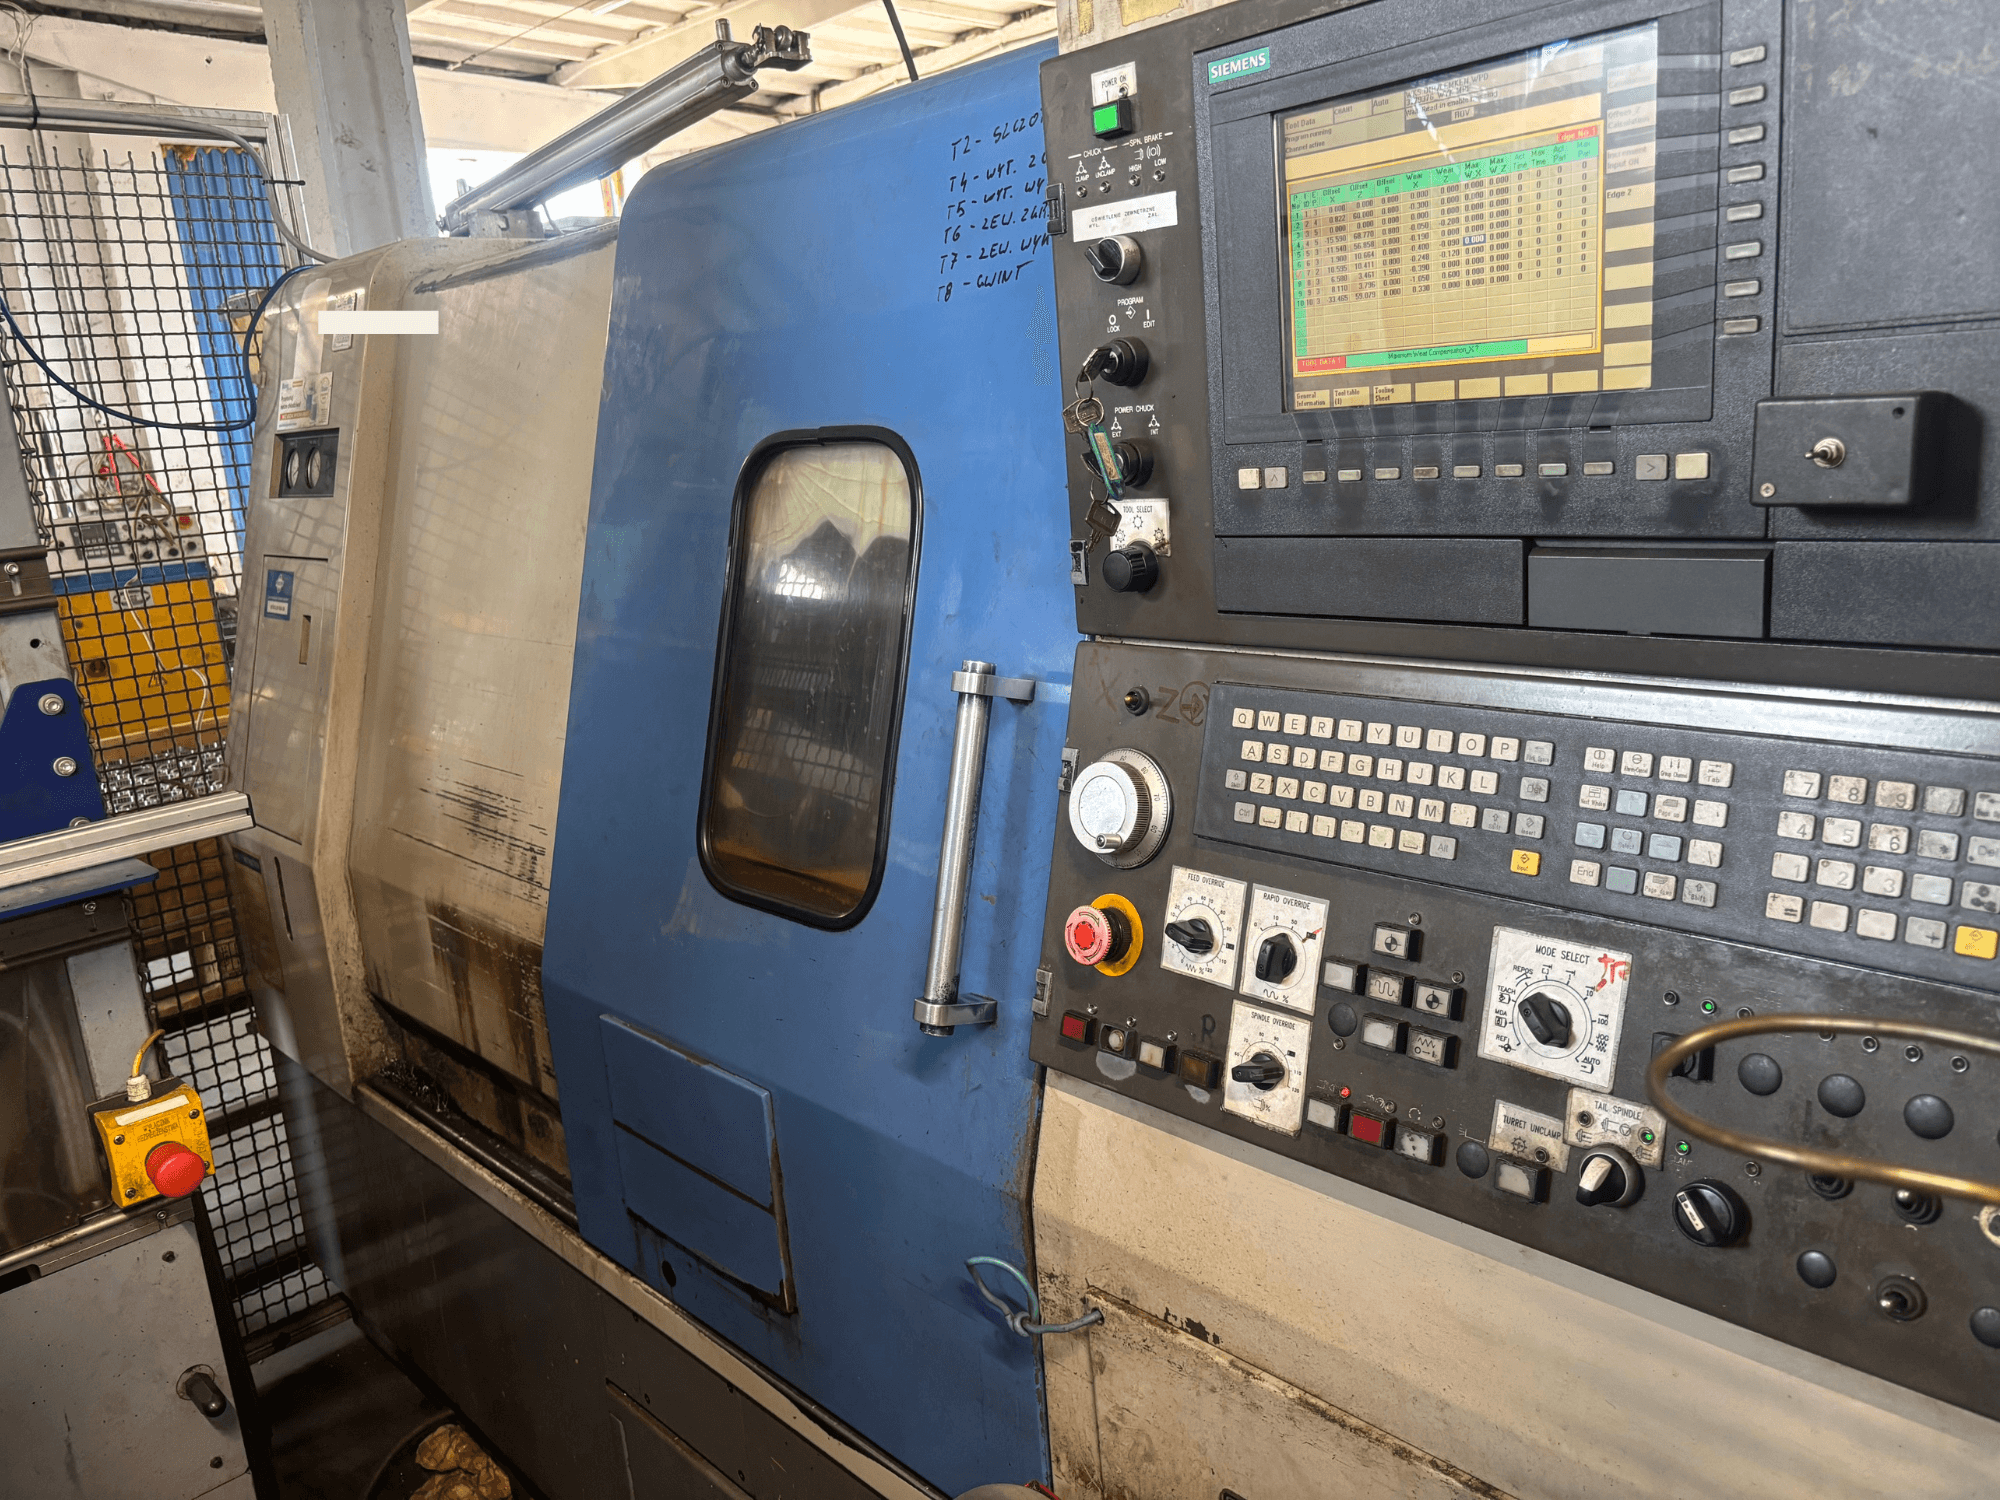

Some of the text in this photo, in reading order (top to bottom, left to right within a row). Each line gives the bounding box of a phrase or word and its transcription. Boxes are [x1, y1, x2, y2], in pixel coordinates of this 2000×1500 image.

[1211, 52, 1266, 79] SIEMENS
[1101, 74, 1126, 89] POWER ON
[1373, 98, 1389, 107] Auto
[1285, 118, 1316, 130] Tool Data
[1144, 132, 1162, 144] BRAKE
[1083, 147, 1102, 158] CHUCK
[1128, 164, 1142, 172] HIGH
[1154, 158, 1167, 167] LOW
[1075, 174, 1090, 183] CLAMP
[1095, 168, 1116, 178] UNCLAMP
[1607, 191, 1625, 199] Edge
[1117, 296, 1144, 306] PROGRAM
[1107, 325, 1120, 333] LOCK
[1143, 320, 1155, 328] EDIT
[1114, 404, 1155, 414] POWER CHUCK
[1238, 713, 1247, 724] Q
[1262, 716, 1275, 727] W
[1291, 718, 1299, 730] E
[1318, 721, 1326, 733] R
[1346, 724, 1355, 737] T
[1375, 727, 1384, 740] Y
[1404, 731, 1414, 743] U
[1247, 745, 1256, 757] A
[1466, 739, 1477, 751] O
[1500, 743, 1510, 755] P
[1274, 748, 1282, 760] S
[1300, 752, 1309, 764] D
[1328, 755, 1336, 767] F
[1356, 760, 1365, 772] G
[1385, 764, 1394, 776] H
[1416, 768, 1424, 780] J
[1256, 778, 1265, 790] Z
[1447, 772, 1456, 784] K
[1480, 776, 1488, 789] L
[1282, 782, 1291, 795] X
[1309, 786, 1318, 798] C
[1804, 782, 1814, 796] 7
[1848, 788, 1859, 801] 8
[1337, 790, 1346, 803] V
[1367, 795, 1375, 808] B
[1897, 793, 1907, 809] 9
[1395, 799, 1405, 812] N
[1425, 805, 1436, 817] M
[1796, 824, 1807, 838] 4
[1842, 829, 1854, 844] 5
[1890, 836, 1900, 852] 6
[1577, 866, 1594, 877] End
[1793, 864, 1801, 878] 1
[1188, 873, 1225, 888] FEED OVERRIDE
[1837, 871, 1849, 886] 2
[1883, 878, 1895, 893] 3
[1263, 893, 1311, 910] RAPID OVERRIDE
[1535, 945, 1590, 965] MODE SELECT
[1513, 965, 1533, 975] REPOS
[1497, 985, 1516, 995] TEACH
[1495, 1008, 1507, 1016] MDA
[1251, 1011, 1295, 1030] SPINDLE OVERRIDE
[1584, 1056, 1600, 1065] AUTO
[1594, 1100, 1642, 1121] TAIL SPINDLE
[1503, 1114, 1562, 1140] TURRET UNCLAMP
